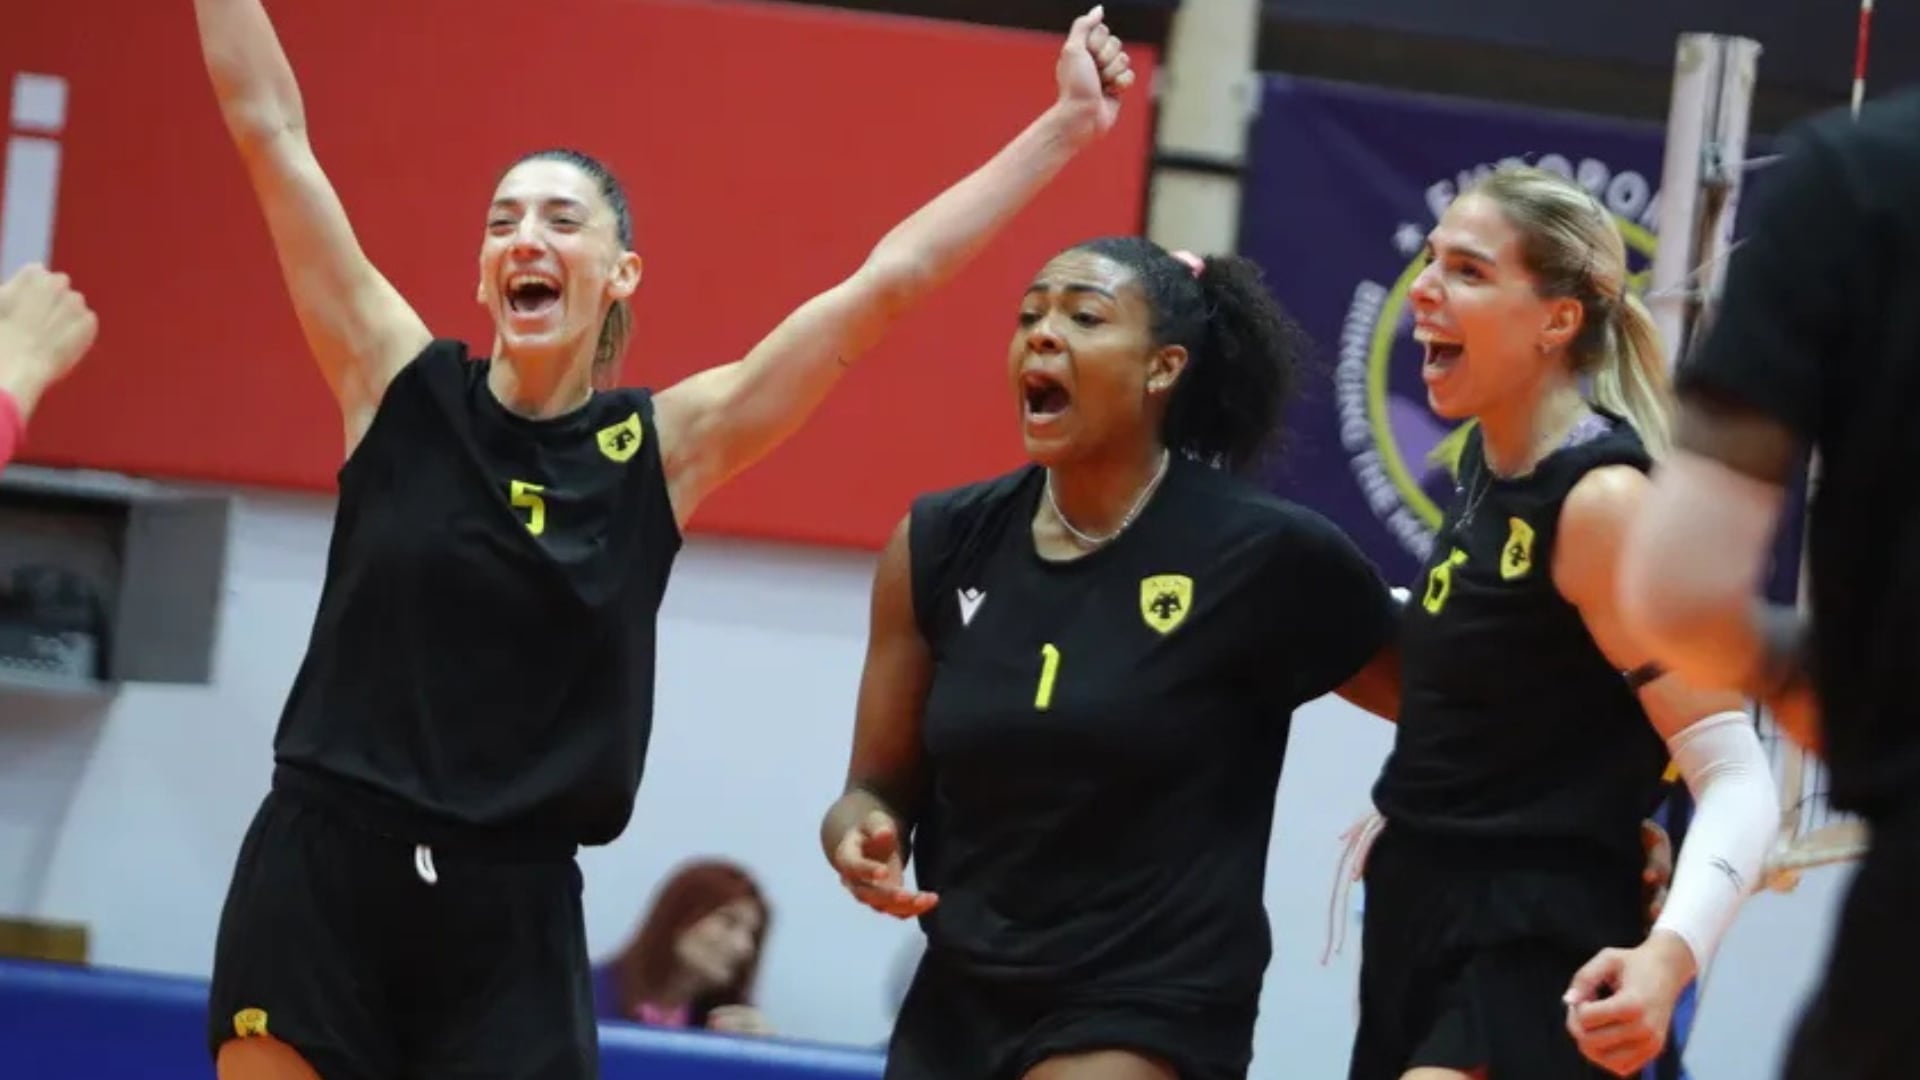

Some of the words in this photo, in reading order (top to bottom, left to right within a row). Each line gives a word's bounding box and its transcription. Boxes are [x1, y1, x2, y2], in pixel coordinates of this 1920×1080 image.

[511, 479, 545, 535] 5
[1350, 450, 1400, 519] THE
[1034, 642, 1060, 709] 1
